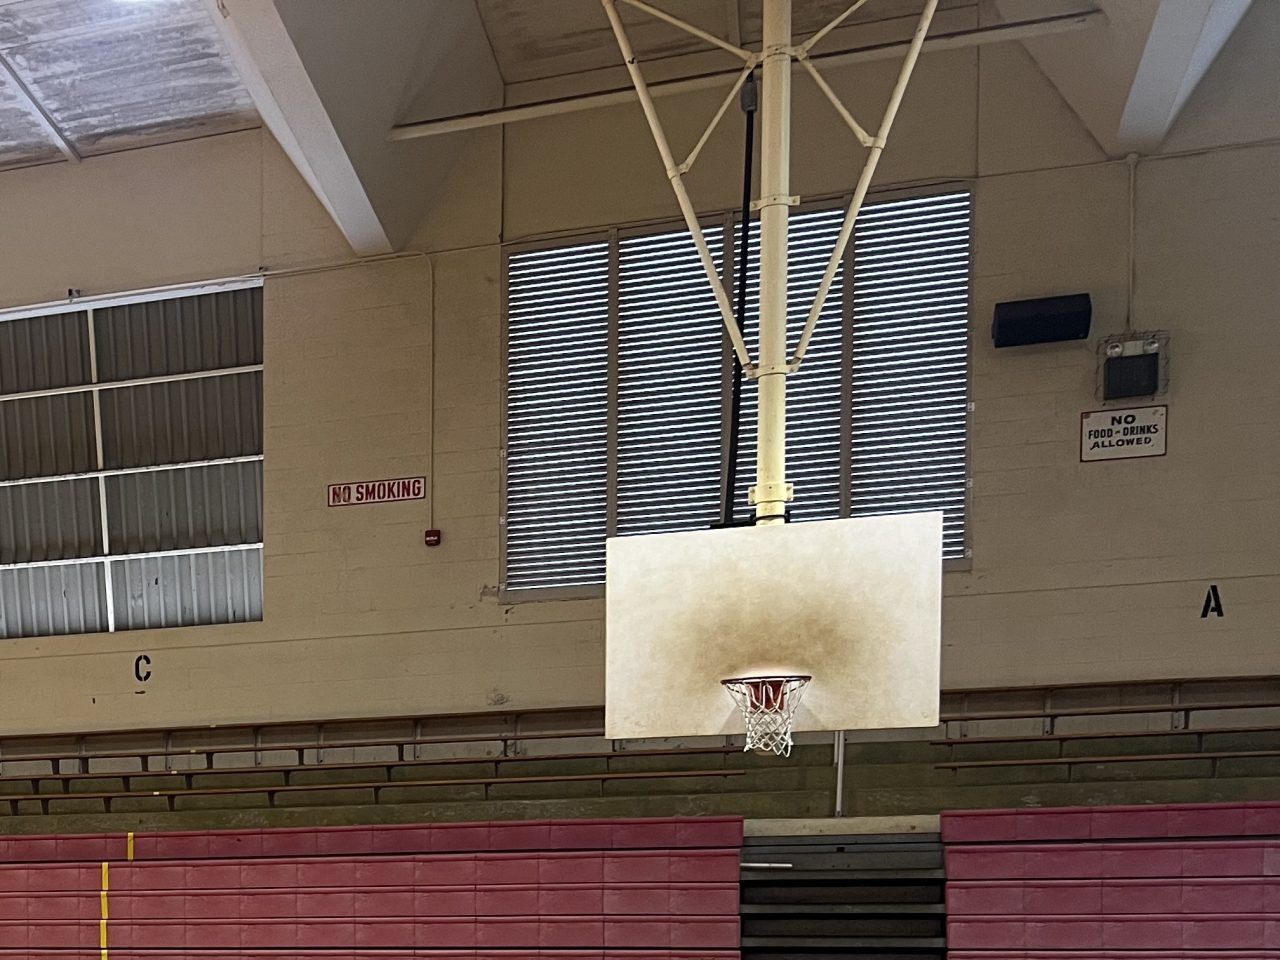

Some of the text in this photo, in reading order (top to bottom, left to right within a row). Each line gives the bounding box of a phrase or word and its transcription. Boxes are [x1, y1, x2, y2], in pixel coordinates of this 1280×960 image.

[1111, 414, 1136, 426] NO
[1088, 428, 1113, 440] FOOD
[1122, 424, 1159, 437] DRINKS
[1090, 437, 1152, 451] ALLOWED
[332, 480, 422, 504] NO SMOKING
[1200, 584, 1224, 618] A
[135, 654, 151, 681] C
